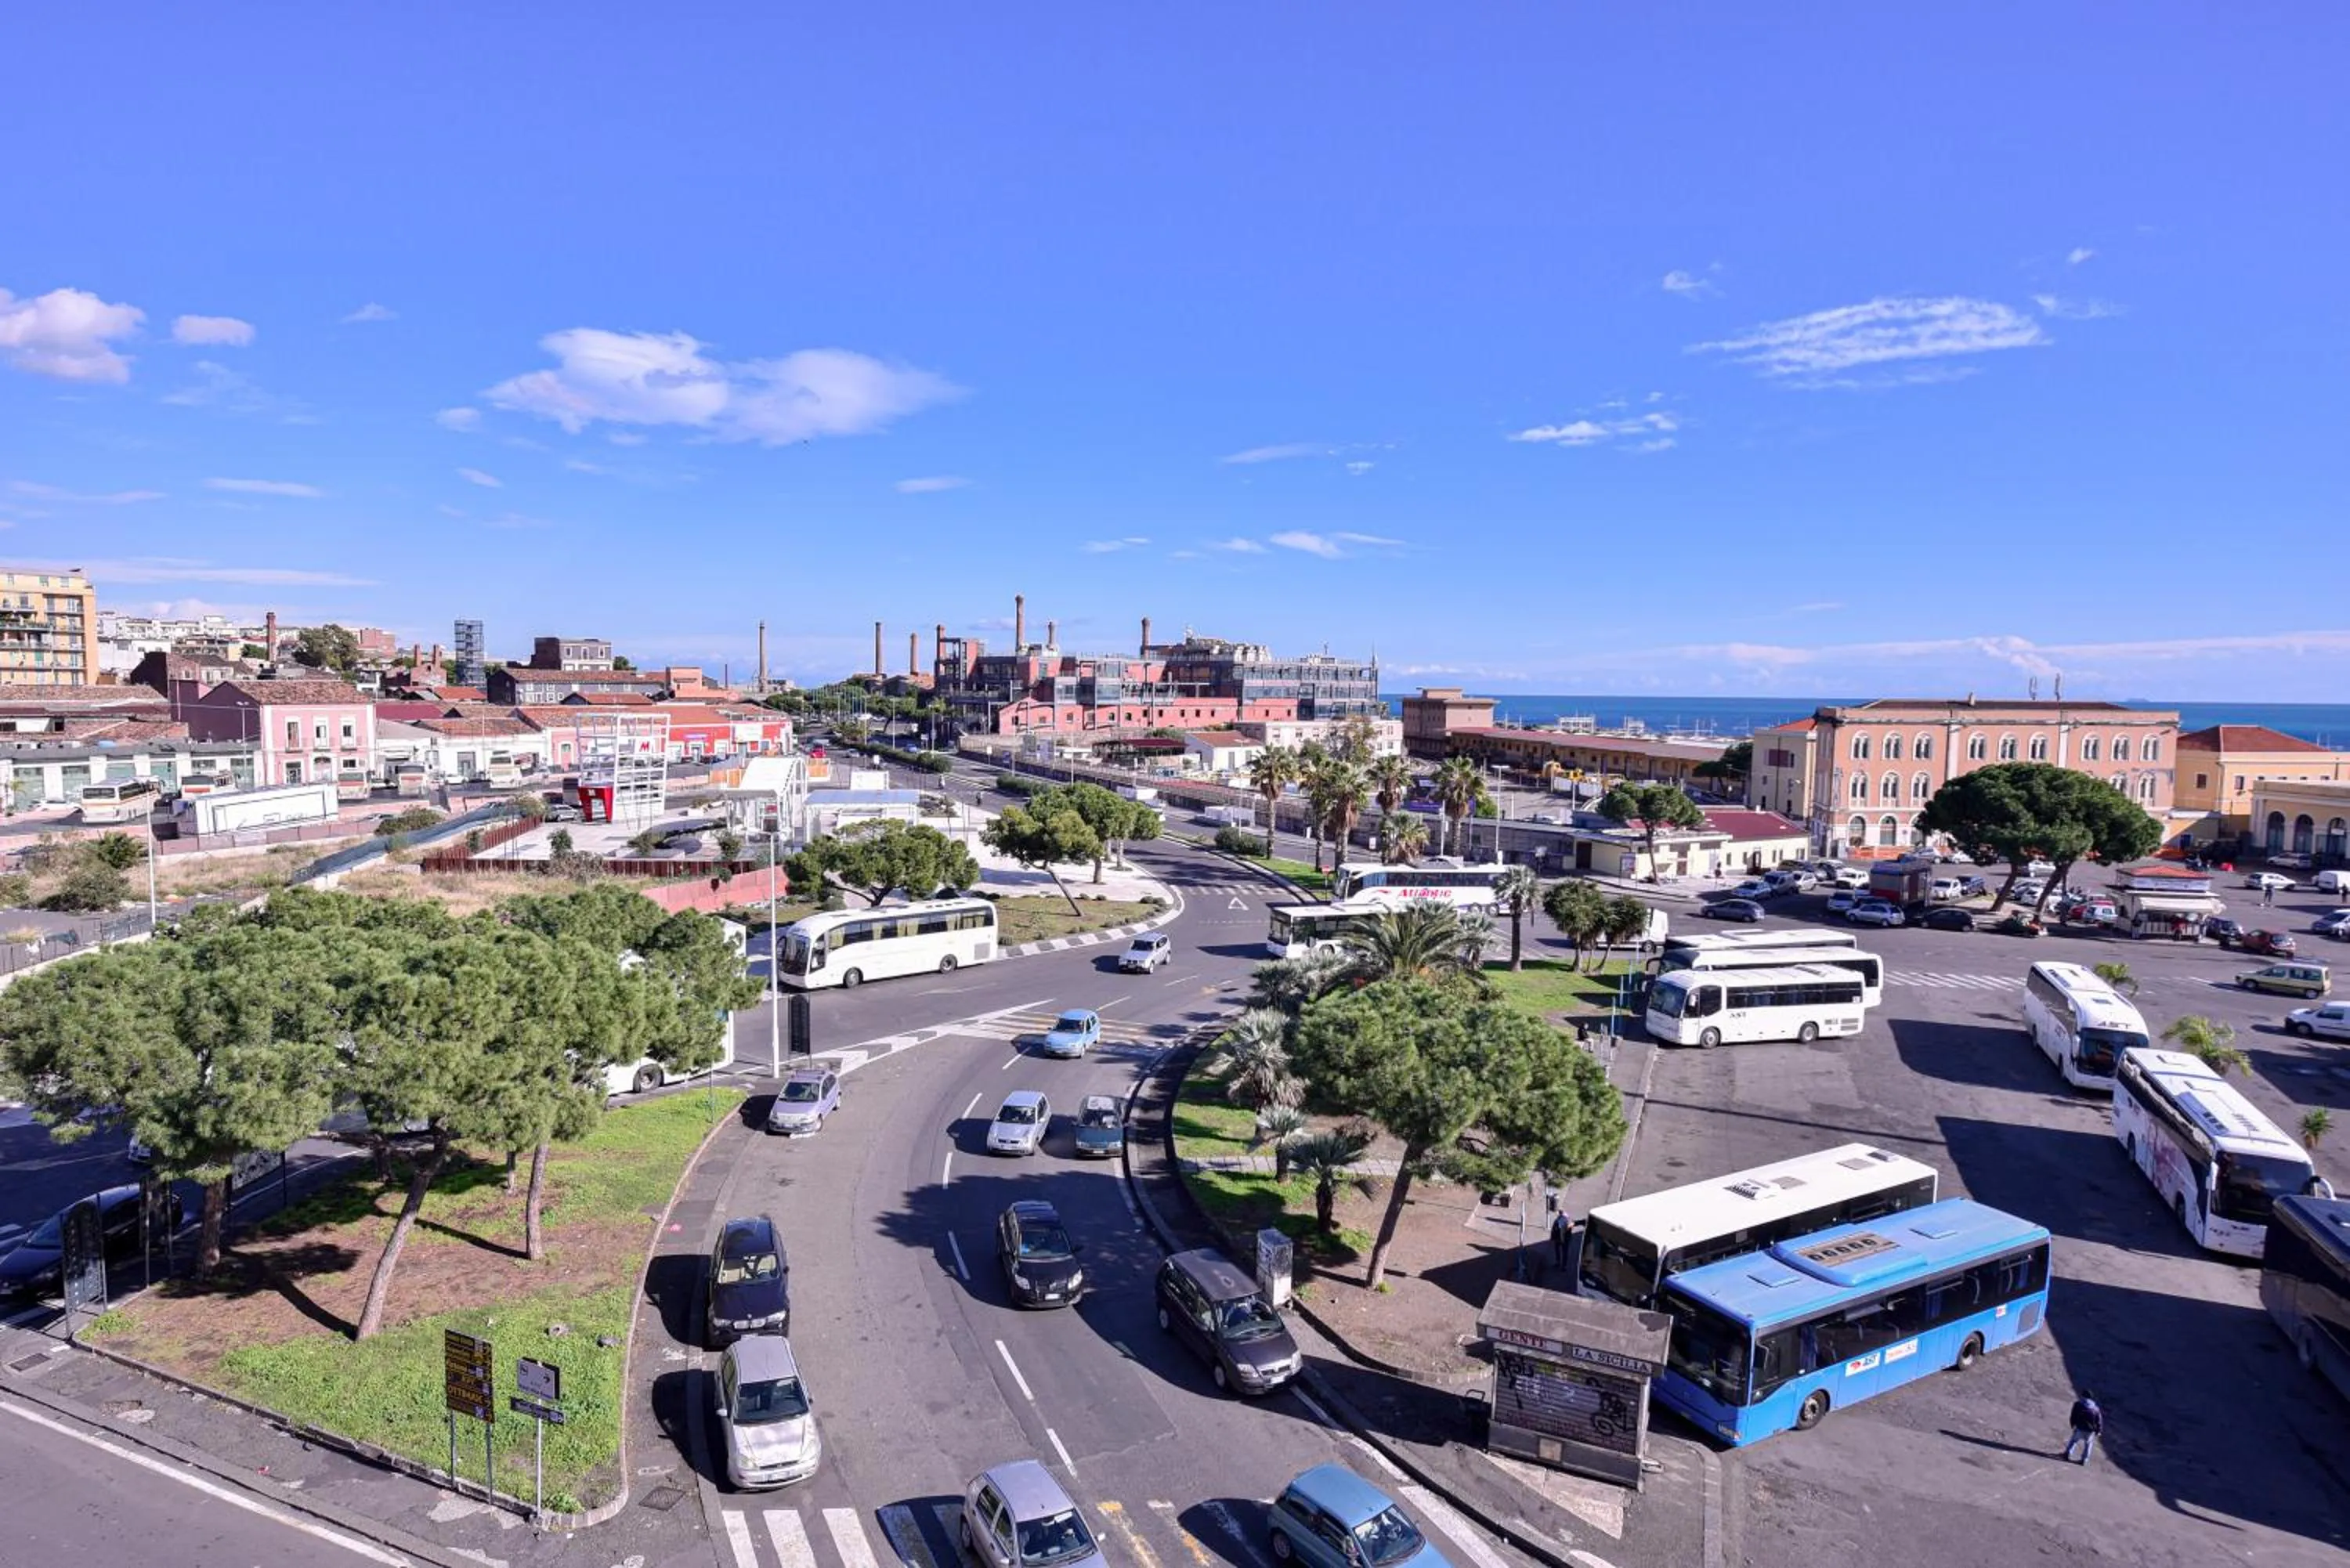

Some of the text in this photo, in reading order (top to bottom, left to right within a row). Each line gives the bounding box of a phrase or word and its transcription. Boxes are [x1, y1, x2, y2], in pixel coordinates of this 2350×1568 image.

[1498, 1329, 1548, 1349] GENTE
[1574, 1346, 1650, 1371] LA SICILIA
